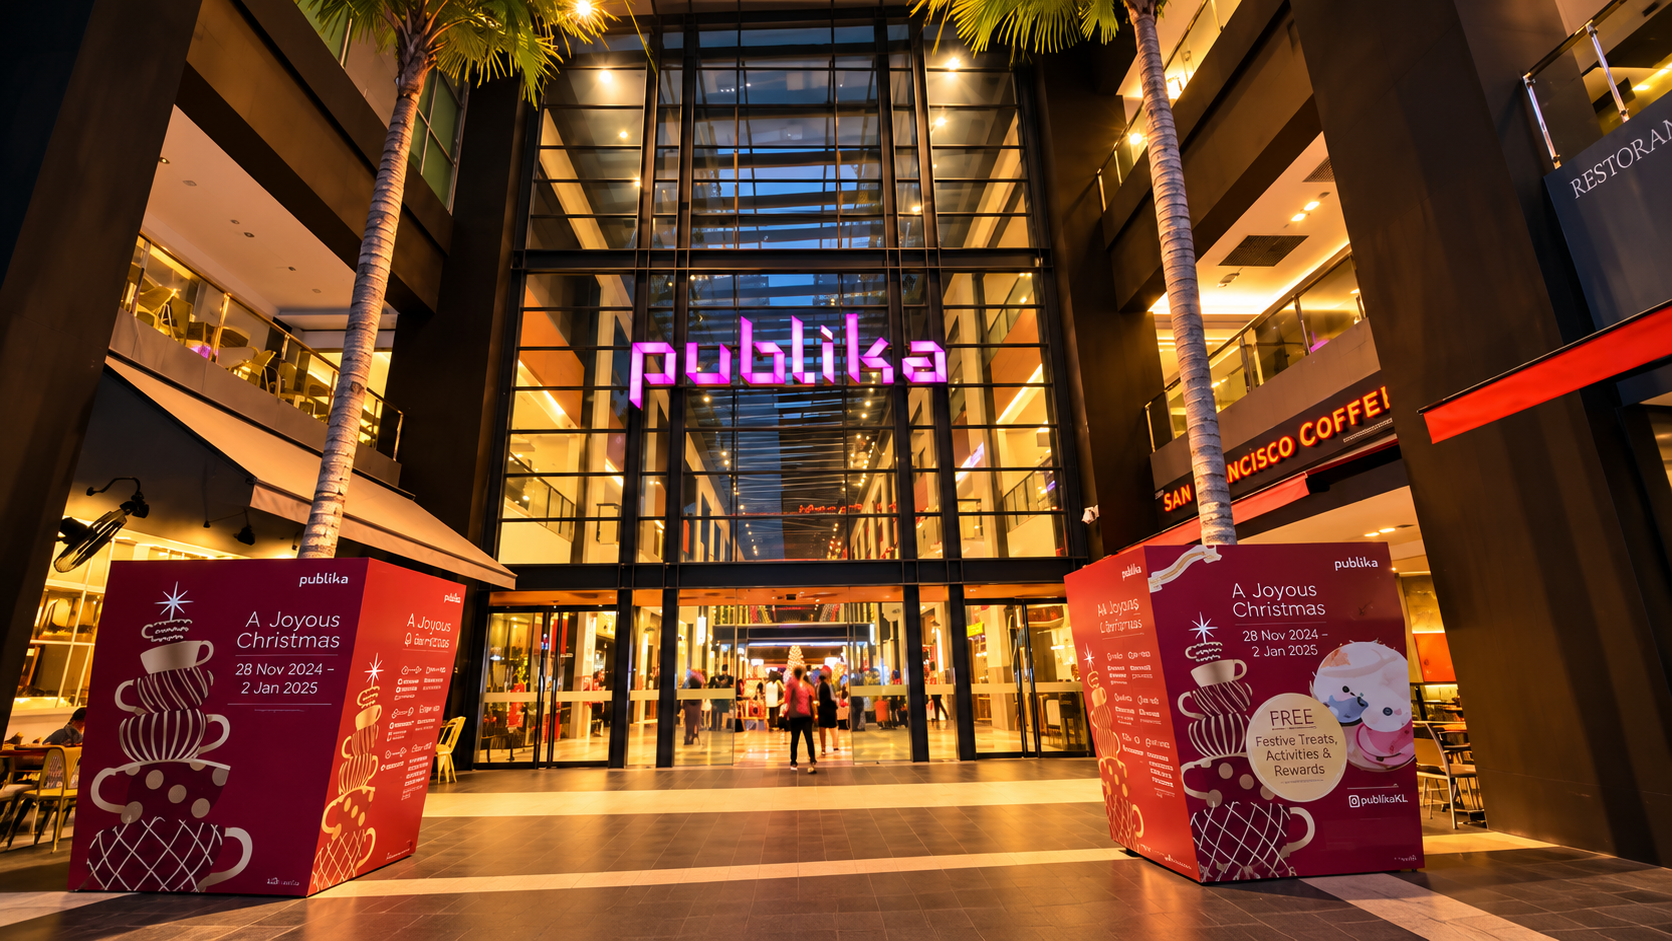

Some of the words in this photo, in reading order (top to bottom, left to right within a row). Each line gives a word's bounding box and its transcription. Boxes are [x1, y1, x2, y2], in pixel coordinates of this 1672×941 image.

[629, 313, 947, 410] publika
[1163, 482, 1192, 512] SAN
[1226, 434, 1296, 484] NCISCO
[1334, 557, 1379, 571] publika
[298, 572, 349, 588] publika
[1232, 583, 1246, 599] A
[1252, 583, 1318, 601] Joyous
[1232, 601, 1326, 618] Christmas
[245, 611, 261, 628] A
[269, 611, 341, 632] Joyous
[406, 612, 415, 628] A
[236, 631, 341, 649] Christmas
[1242, 630, 1258, 642] 28
[1261, 630, 1286, 641] Nov
[1288, 628, 1319, 641] 2024
[1251, 646, 1260, 658] 2
[1264, 646, 1286, 657] Jan
[1287, 644, 1319, 656] 2025
[235, 663, 253, 676] 28
[256, 663, 285, 676] Nov
[288, 663, 323, 676] 2024
[241, 682, 251, 695] 2
[253, 682, 279, 695] Jan
[283, 682, 318, 695] 2025
[1270, 708, 1315, 727] FREE
[1255, 736, 1296, 747] Festive
[1298, 733, 1338, 746] Treats,
[1266, 749, 1319, 762] Activities
[1322, 747, 1332, 759] &
[1274, 764, 1326, 777] Rewards
